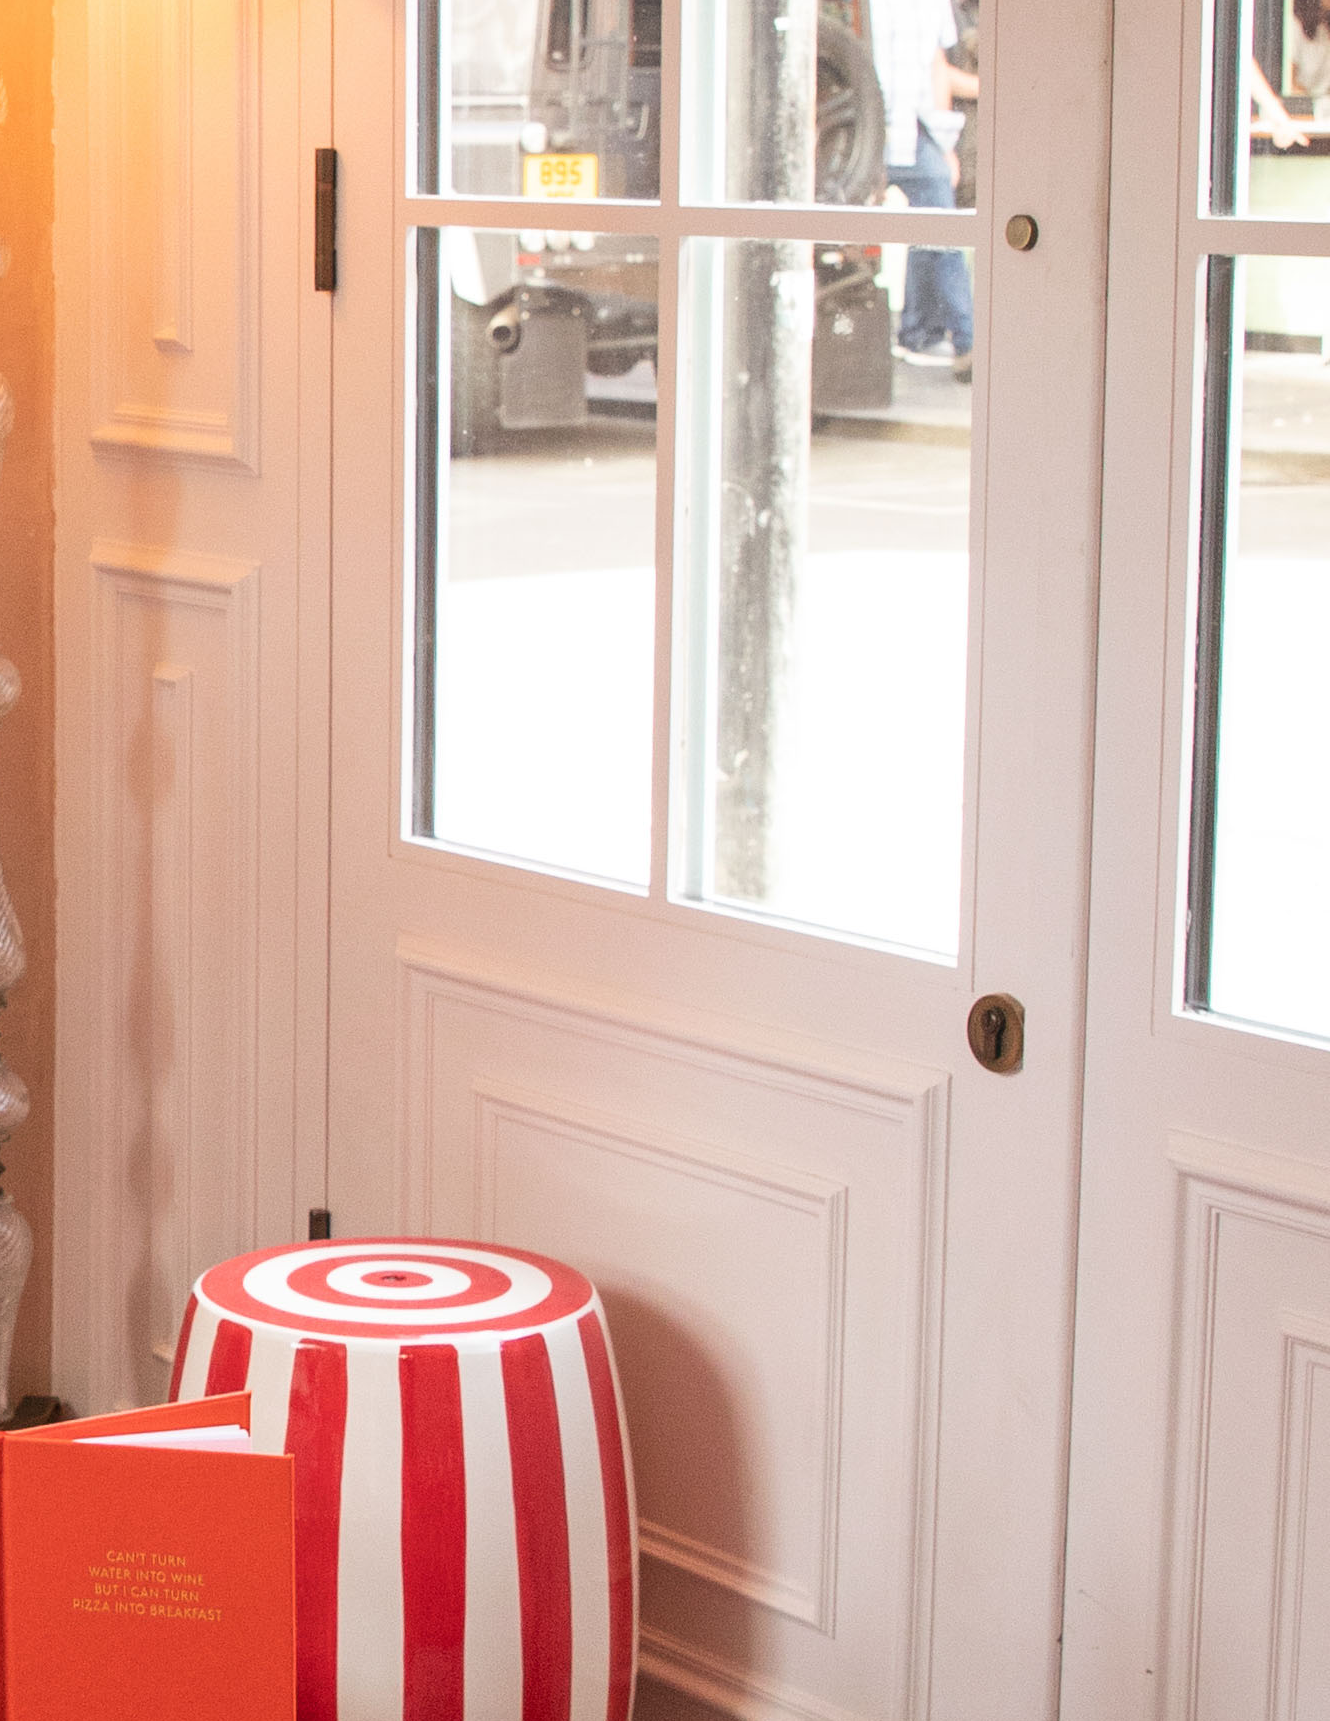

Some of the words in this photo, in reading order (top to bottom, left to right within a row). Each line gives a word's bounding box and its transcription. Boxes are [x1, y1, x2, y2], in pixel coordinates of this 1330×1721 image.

[106, 1550, 146, 1565] CAN'T
[152, 1553, 187, 1568] TURN
[88, 1565, 132, 1581] WATER
[136, 1569, 167, 1584] INTO
[171, 1572, 205, 1587] WINE
[94, 1582, 119, 1596] BUT
[131, 1586, 159, 1599] CAN
[164, 1588, 200, 1602] TURN
[73, 1598, 111, 1613] PIZZA
[115, 1601, 146, 1616] INTO
[150, 1604, 222, 1622] BREAKFAST
